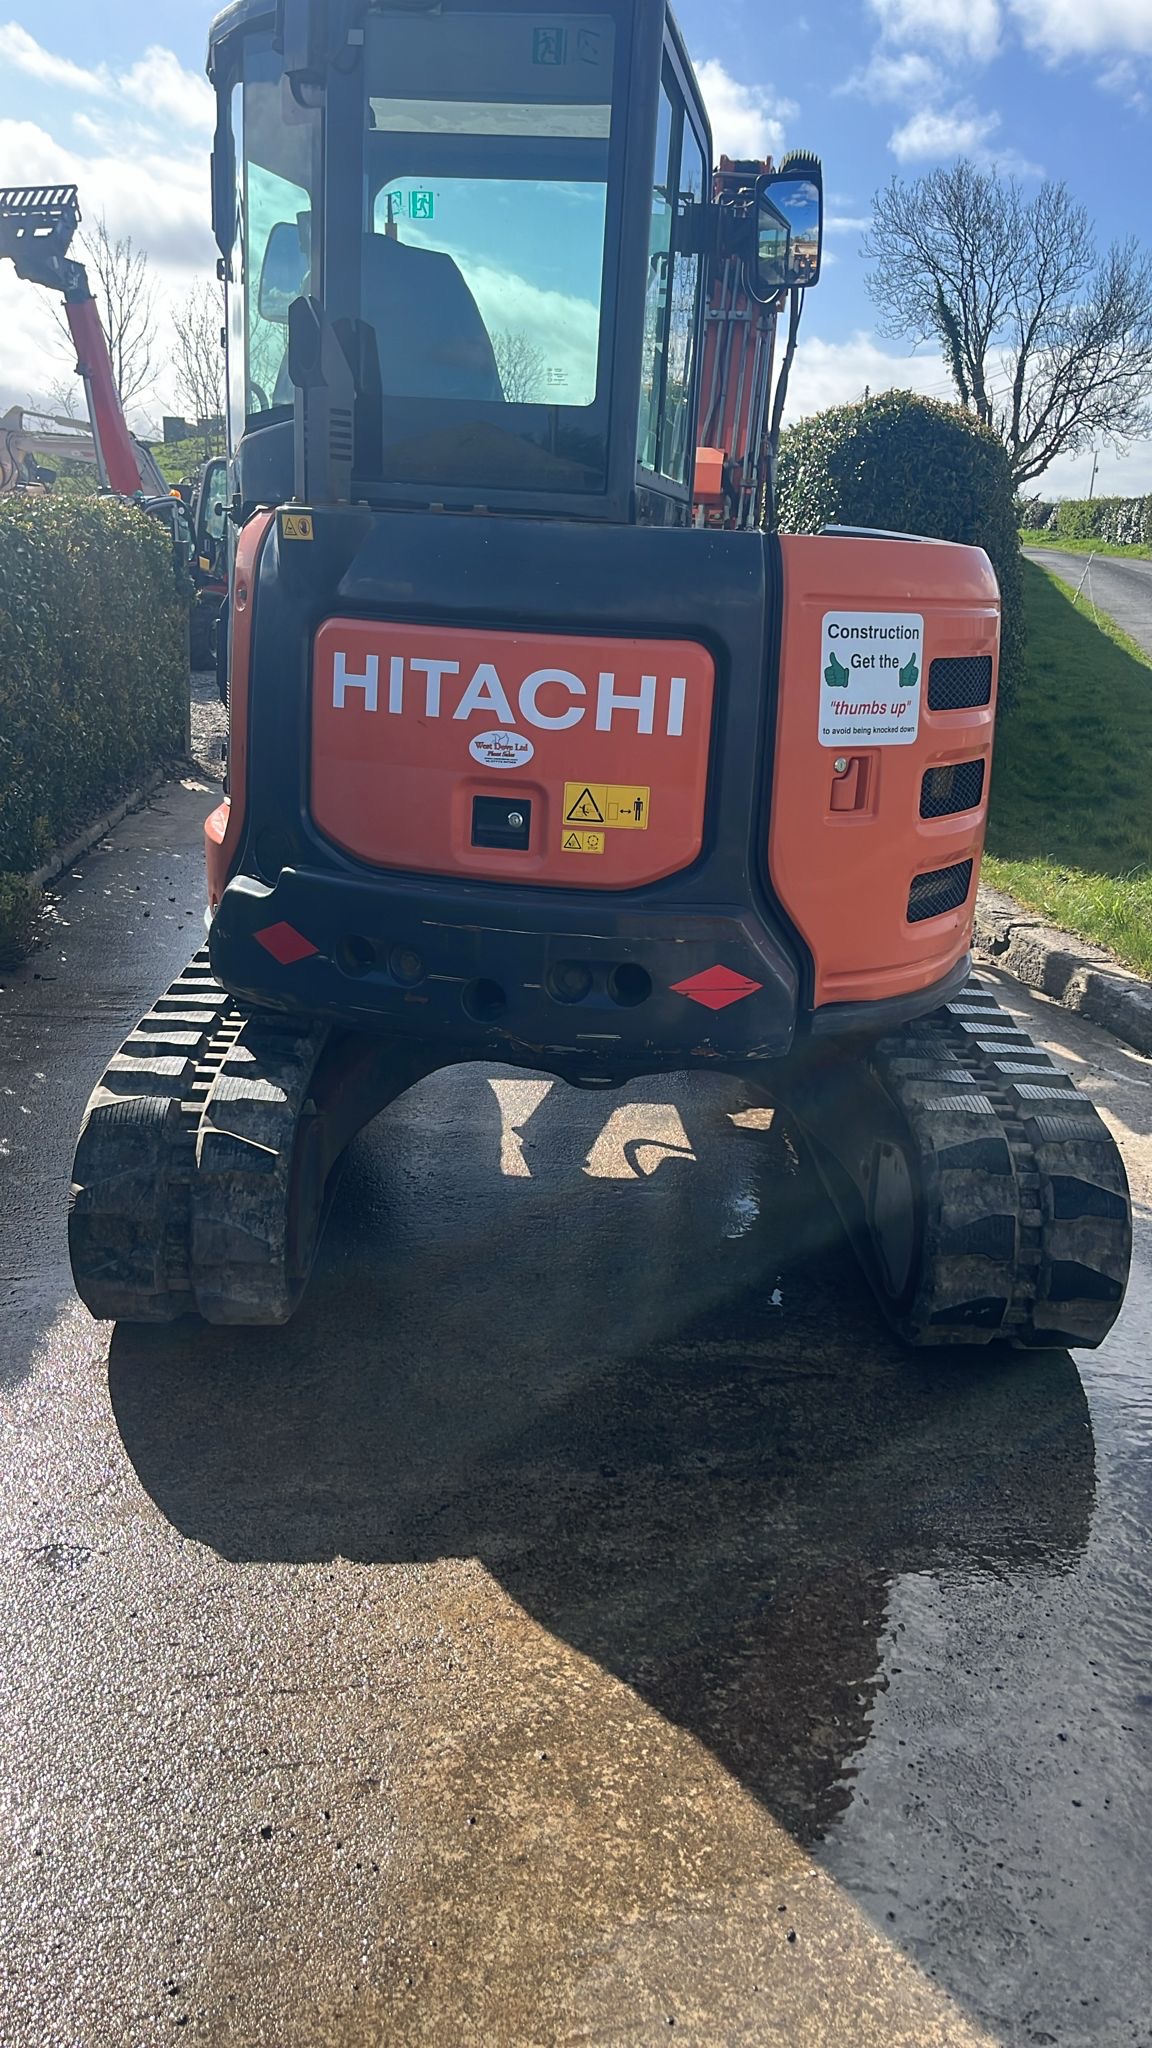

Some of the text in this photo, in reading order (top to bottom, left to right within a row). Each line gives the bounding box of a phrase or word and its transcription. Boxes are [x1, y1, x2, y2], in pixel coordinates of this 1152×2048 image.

[827, 623, 920, 640] Construction
[850, 653, 899, 669] Get the
[332, 651, 687, 737] HITACHI
[830, 700, 912, 718] "thumbs up"
[822, 725, 915, 735] to avoid being knocked down
[474, 742, 493, 750] West
[514, 743, 528, 751] Ltd
